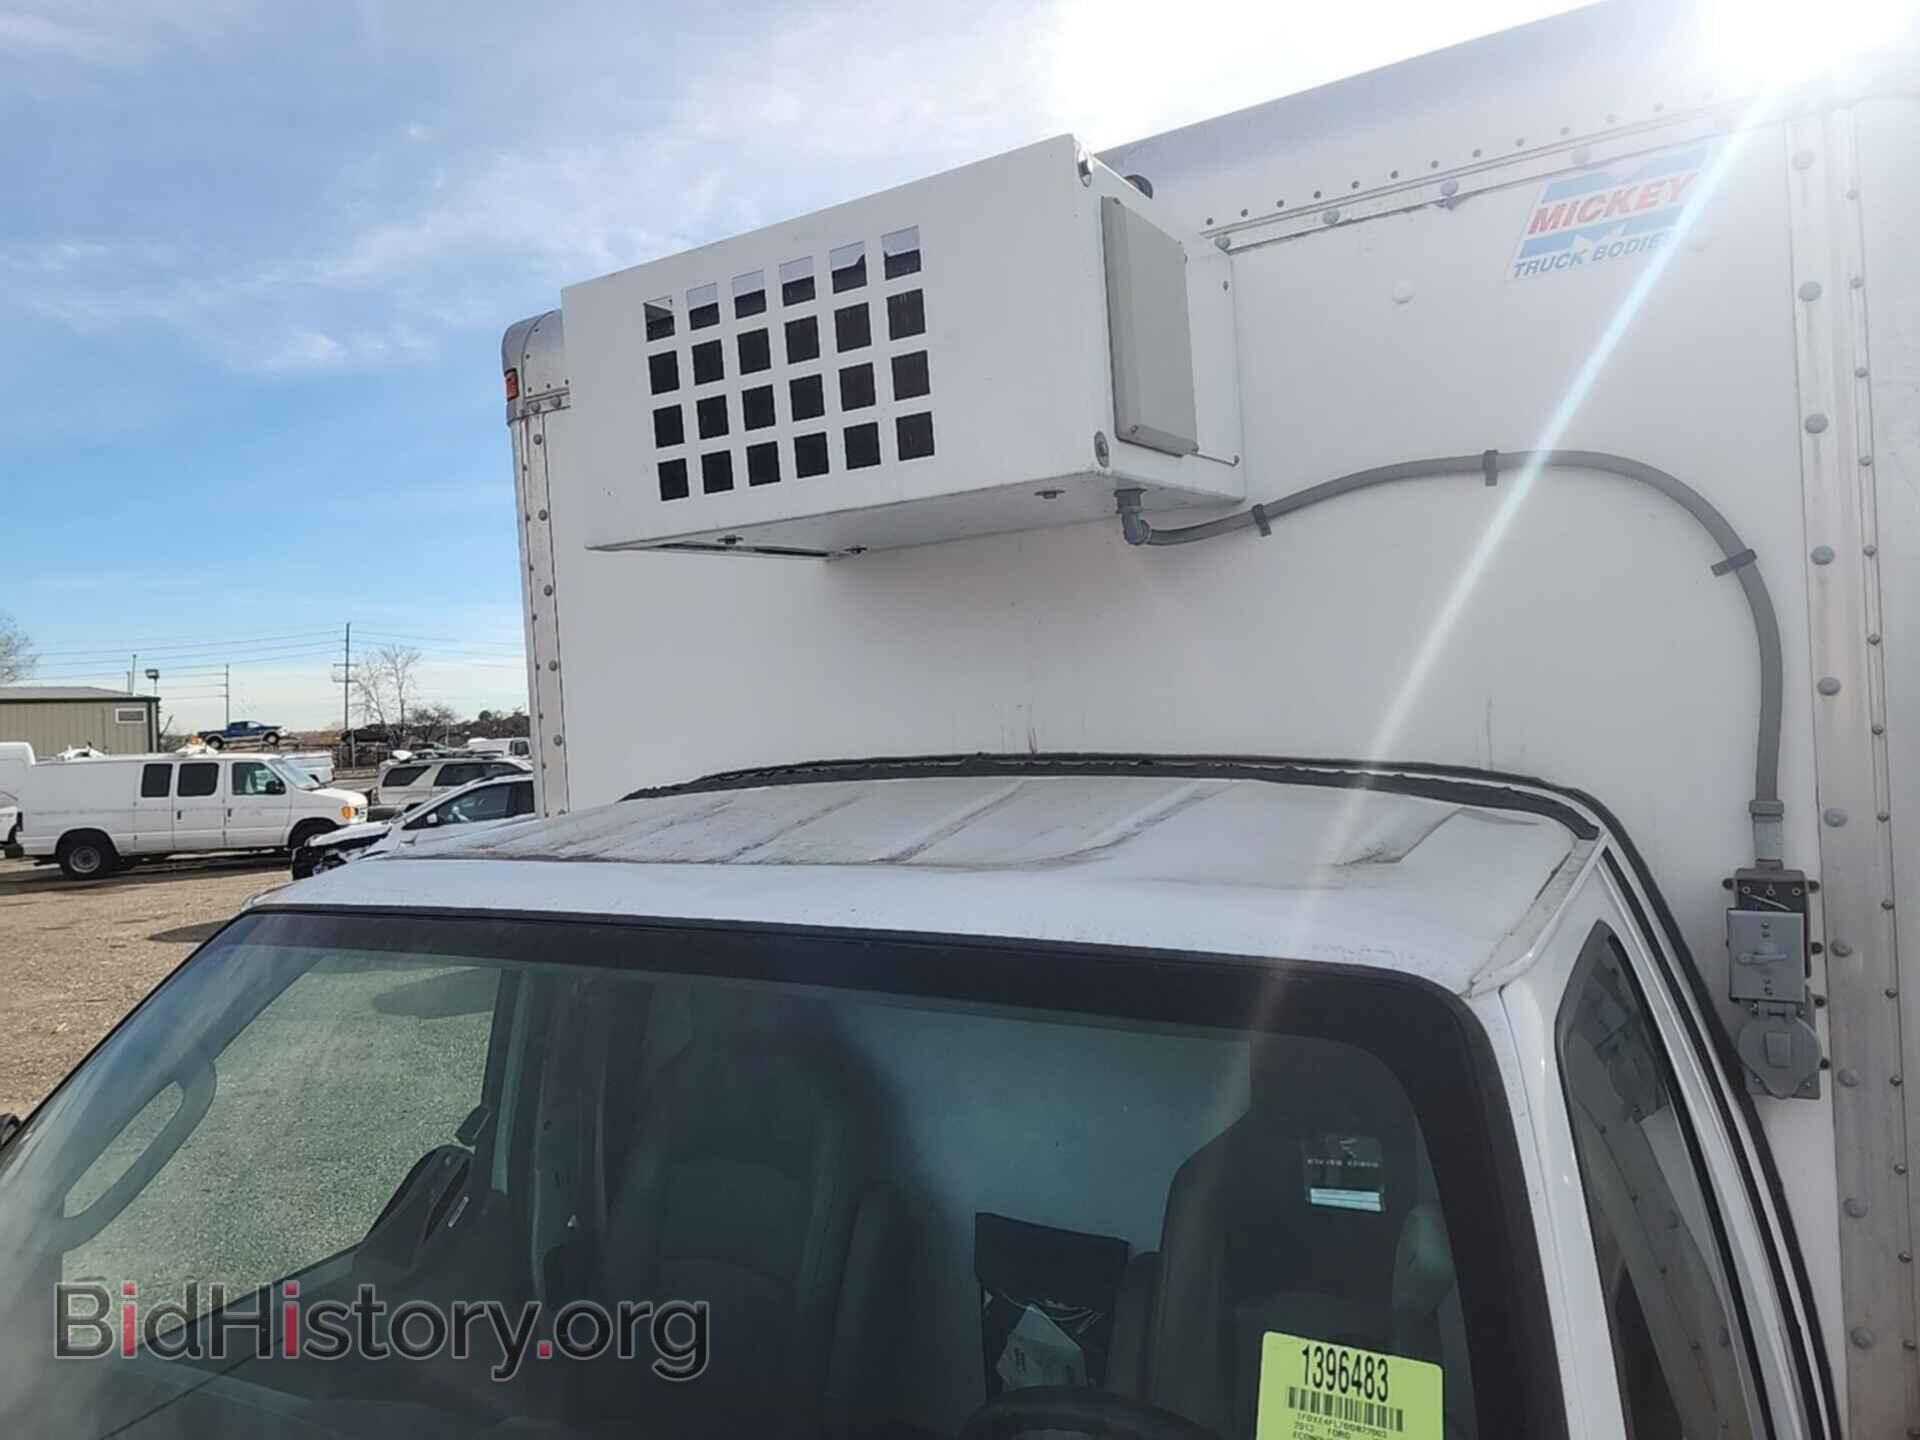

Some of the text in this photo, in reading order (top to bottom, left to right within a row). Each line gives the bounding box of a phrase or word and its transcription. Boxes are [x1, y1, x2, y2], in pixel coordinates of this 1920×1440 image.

[1528, 170, 1698, 235] MICKEY
[1513, 249, 1586, 278] TRUCK
[1301, 1344, 1389, 1403] 1396483
